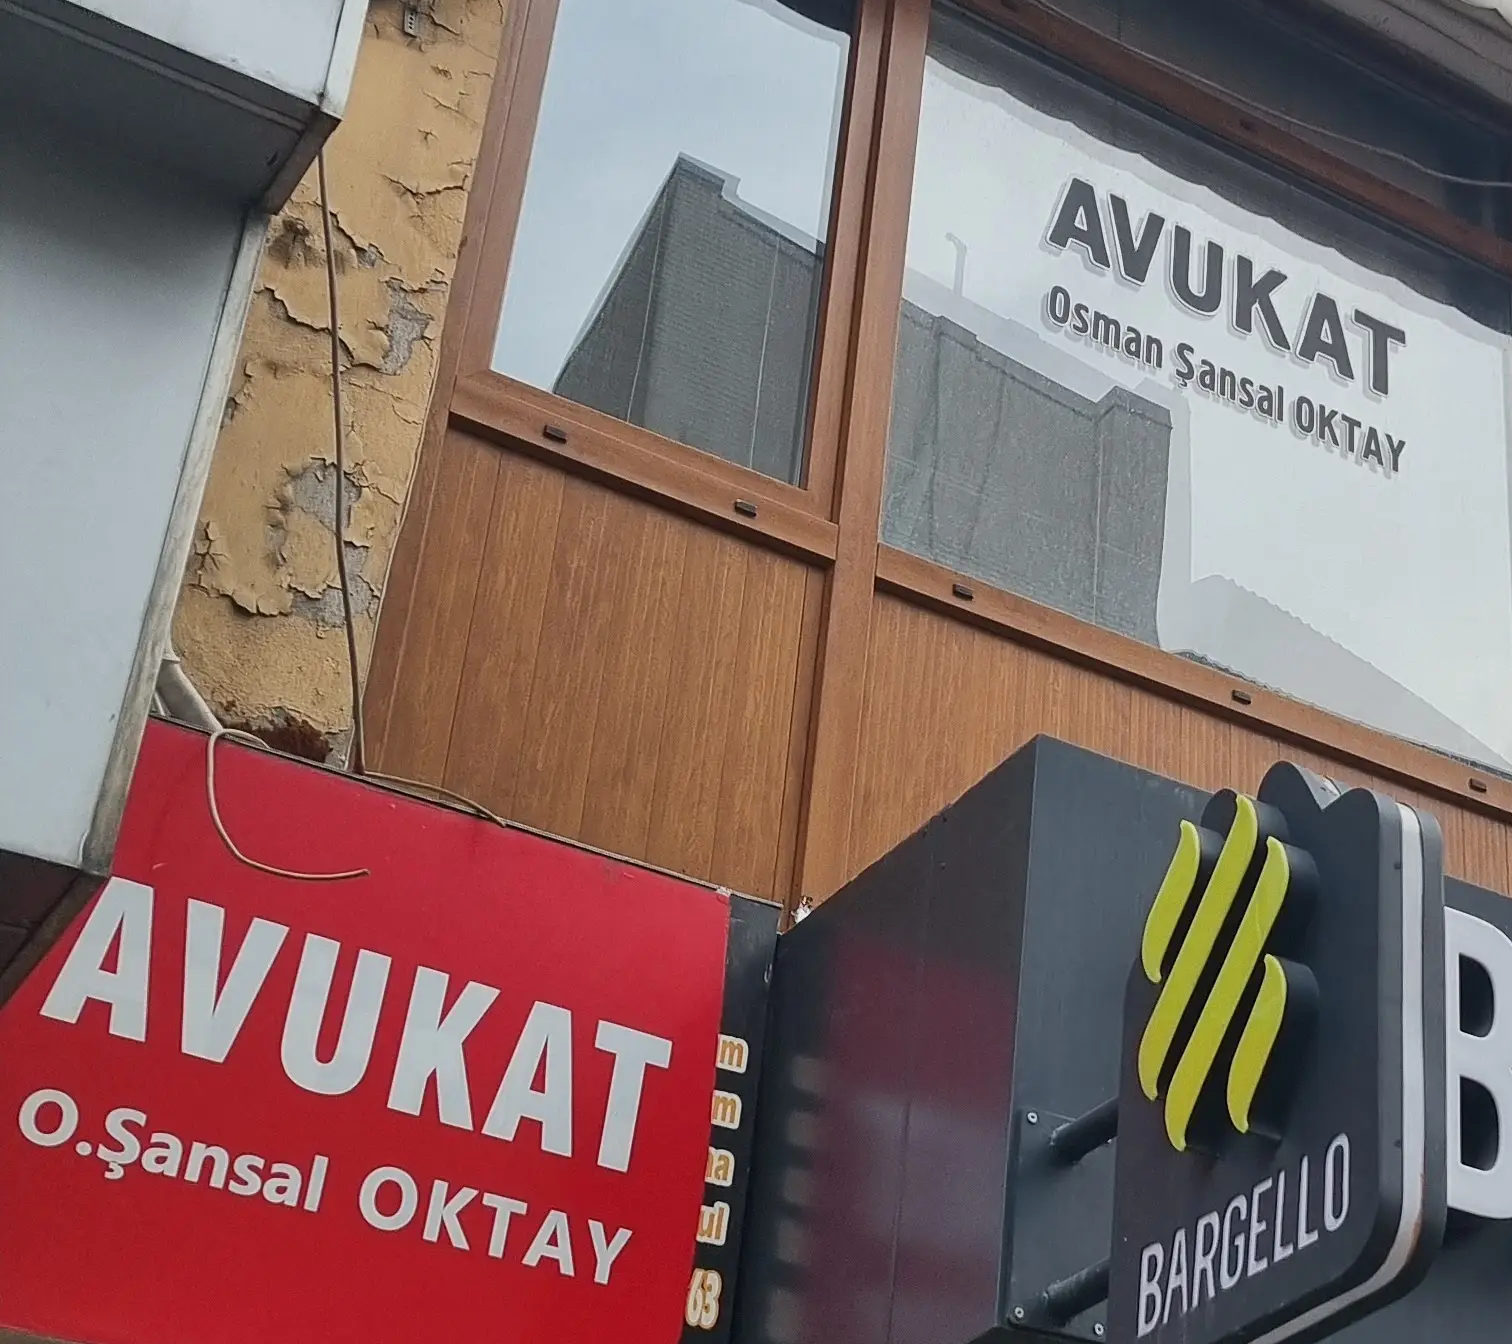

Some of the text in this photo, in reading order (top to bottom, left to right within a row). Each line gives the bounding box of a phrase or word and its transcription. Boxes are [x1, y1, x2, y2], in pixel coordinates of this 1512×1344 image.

[1046, 176, 1406, 396] AVUKAT
[1047, 284, 1406, 473] Osman Şansal OKTAY
[39, 874, 673, 1174] AVUKAT
[17, 1087, 634, 1287] O.Şansal OKTAY
[1136, 1131, 1351, 1339] BARGELLO
